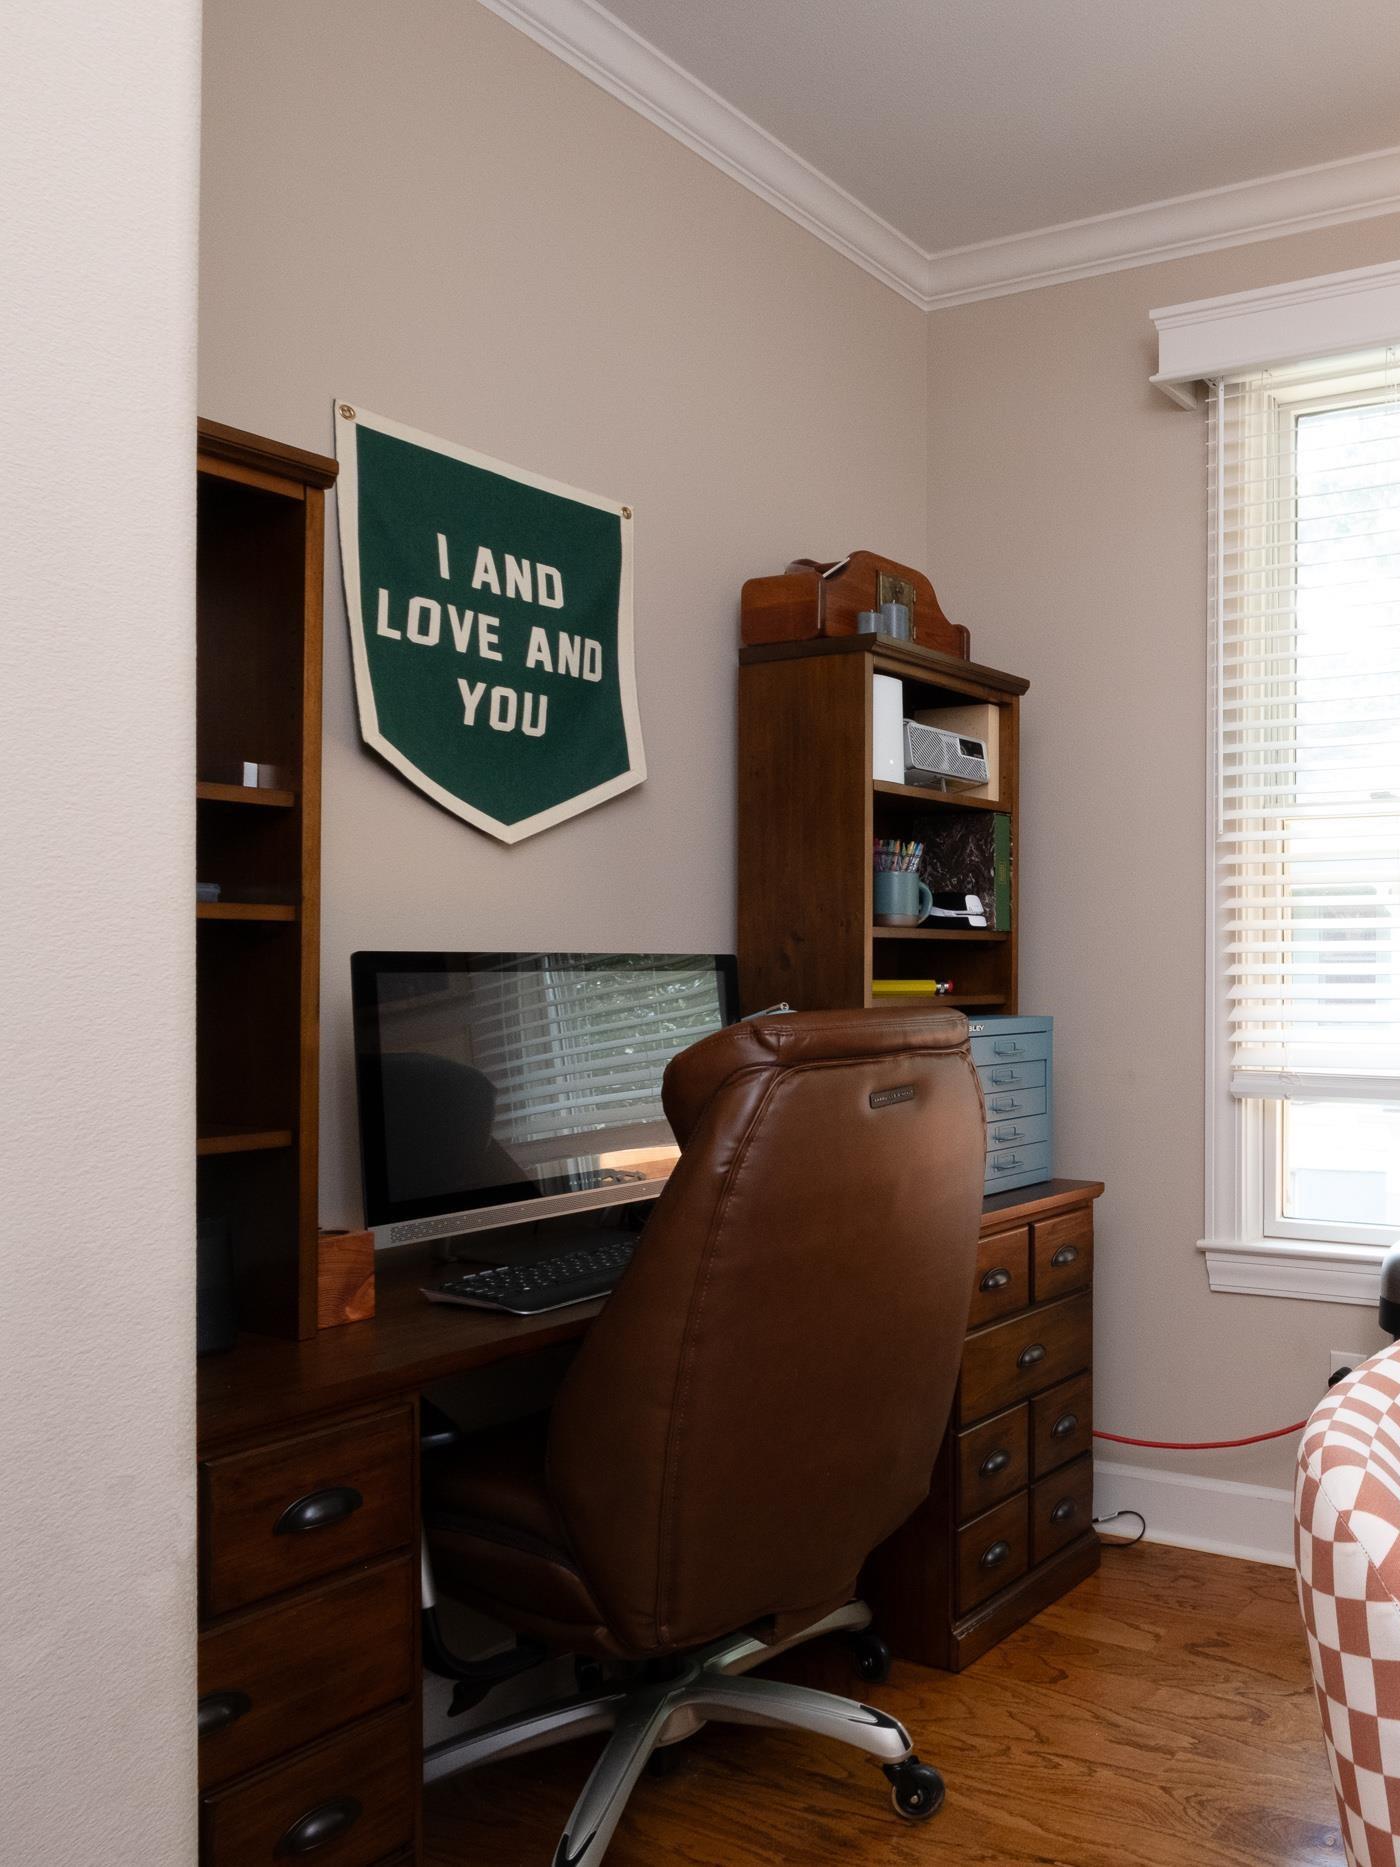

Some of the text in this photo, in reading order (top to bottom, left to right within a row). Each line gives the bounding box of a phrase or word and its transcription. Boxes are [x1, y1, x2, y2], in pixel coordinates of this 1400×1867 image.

[436, 532, 564, 609] I AND
[376, 588, 602, 683] LOVE AND
[457, 678, 548, 737] YOU
